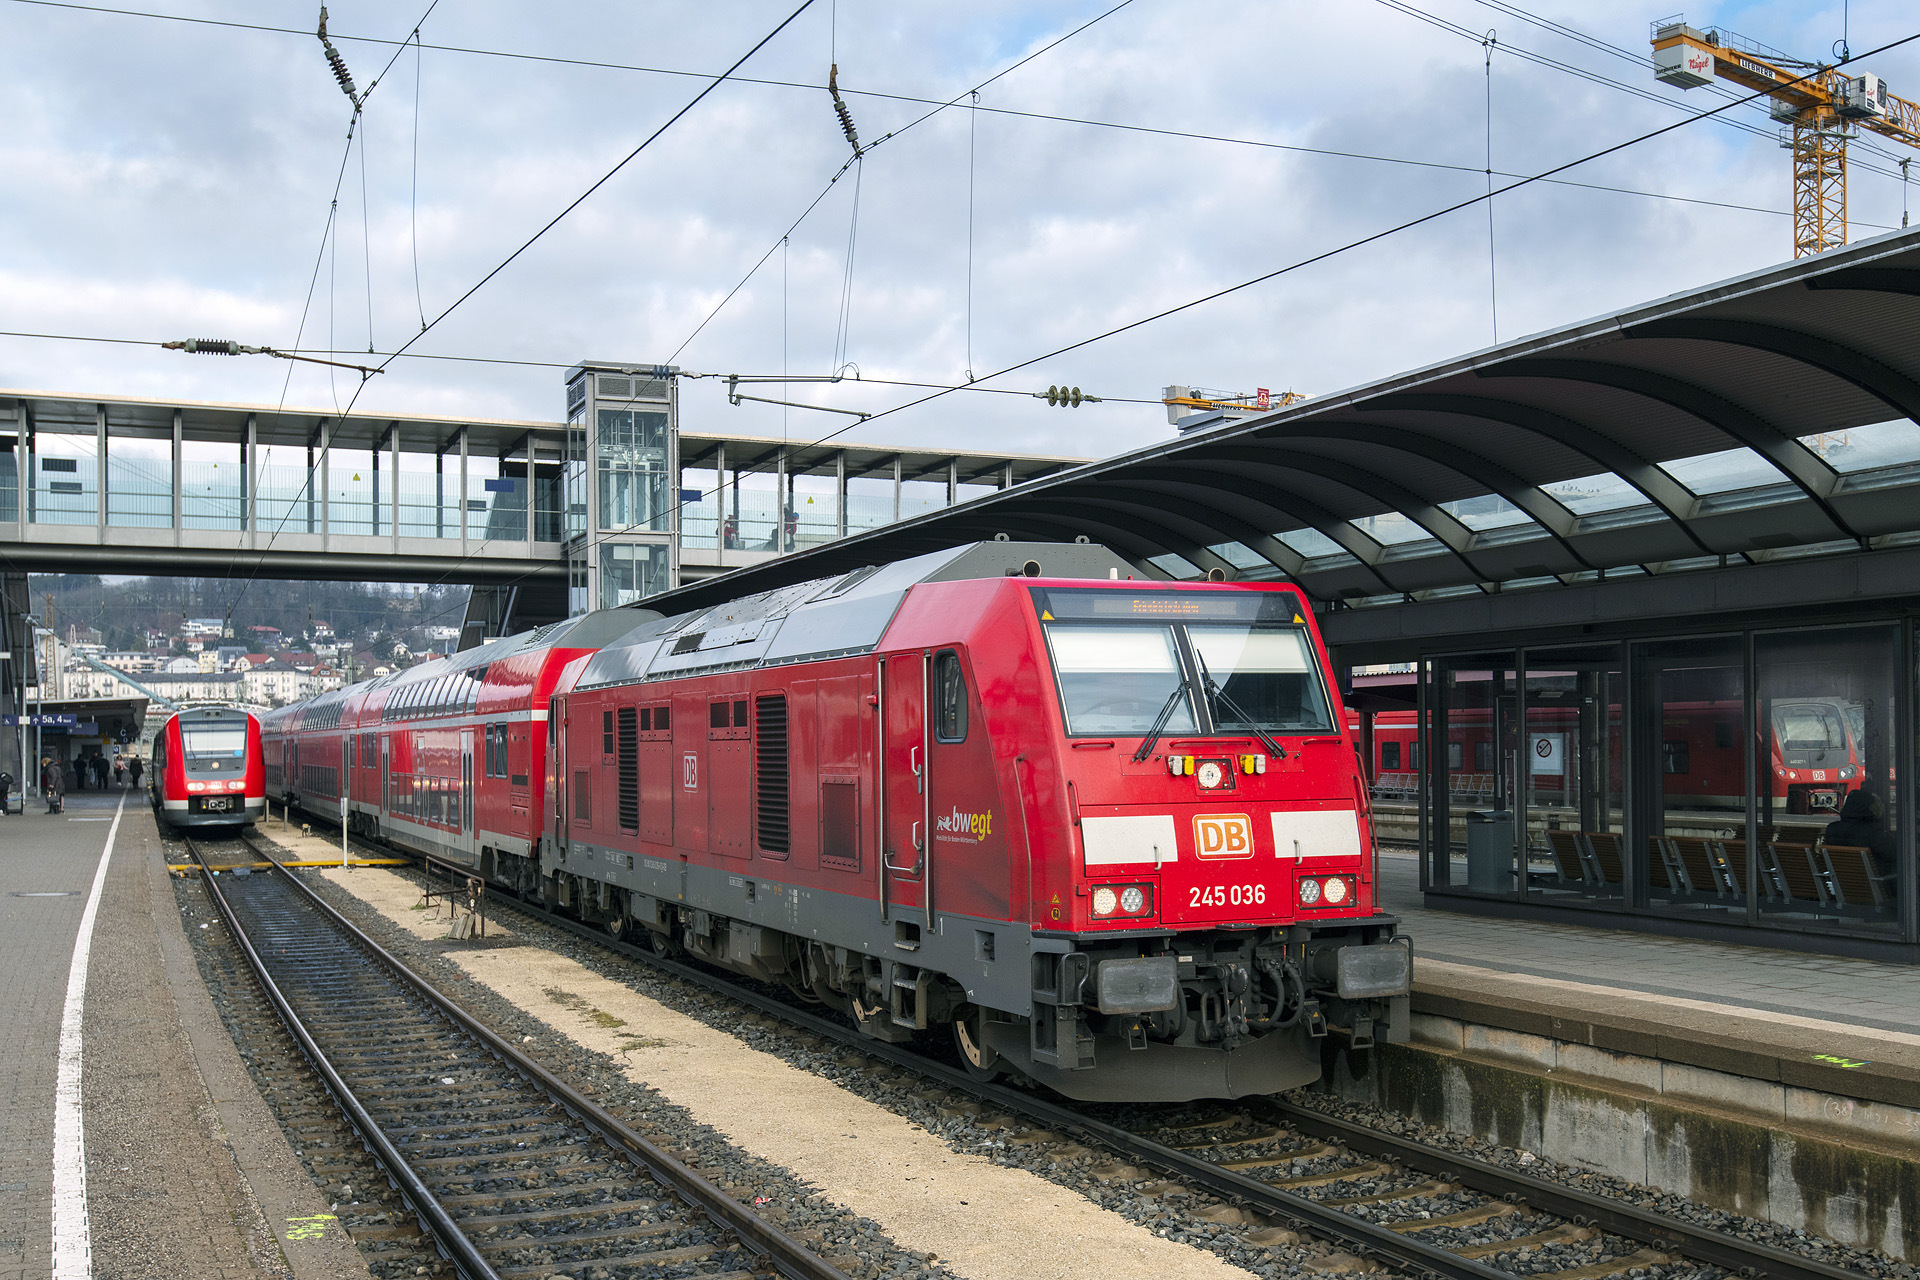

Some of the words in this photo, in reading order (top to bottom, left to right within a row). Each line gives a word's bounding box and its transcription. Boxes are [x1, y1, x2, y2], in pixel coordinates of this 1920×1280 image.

[1688, 55, 1710, 73] Nagel
[1741, 60, 1774, 79] LIEBHERR
[42, 714, 55, 724] 5a,
[56, 714, 63, 723] 4
[685, 758, 696, 785] DB
[1814, 771, 1825, 780] DB
[952, 805, 992, 841] bwegt
[1201, 821, 1247, 852] DB
[1189, 885, 1226, 907] 245
[1230, 884, 1266, 905] 036
